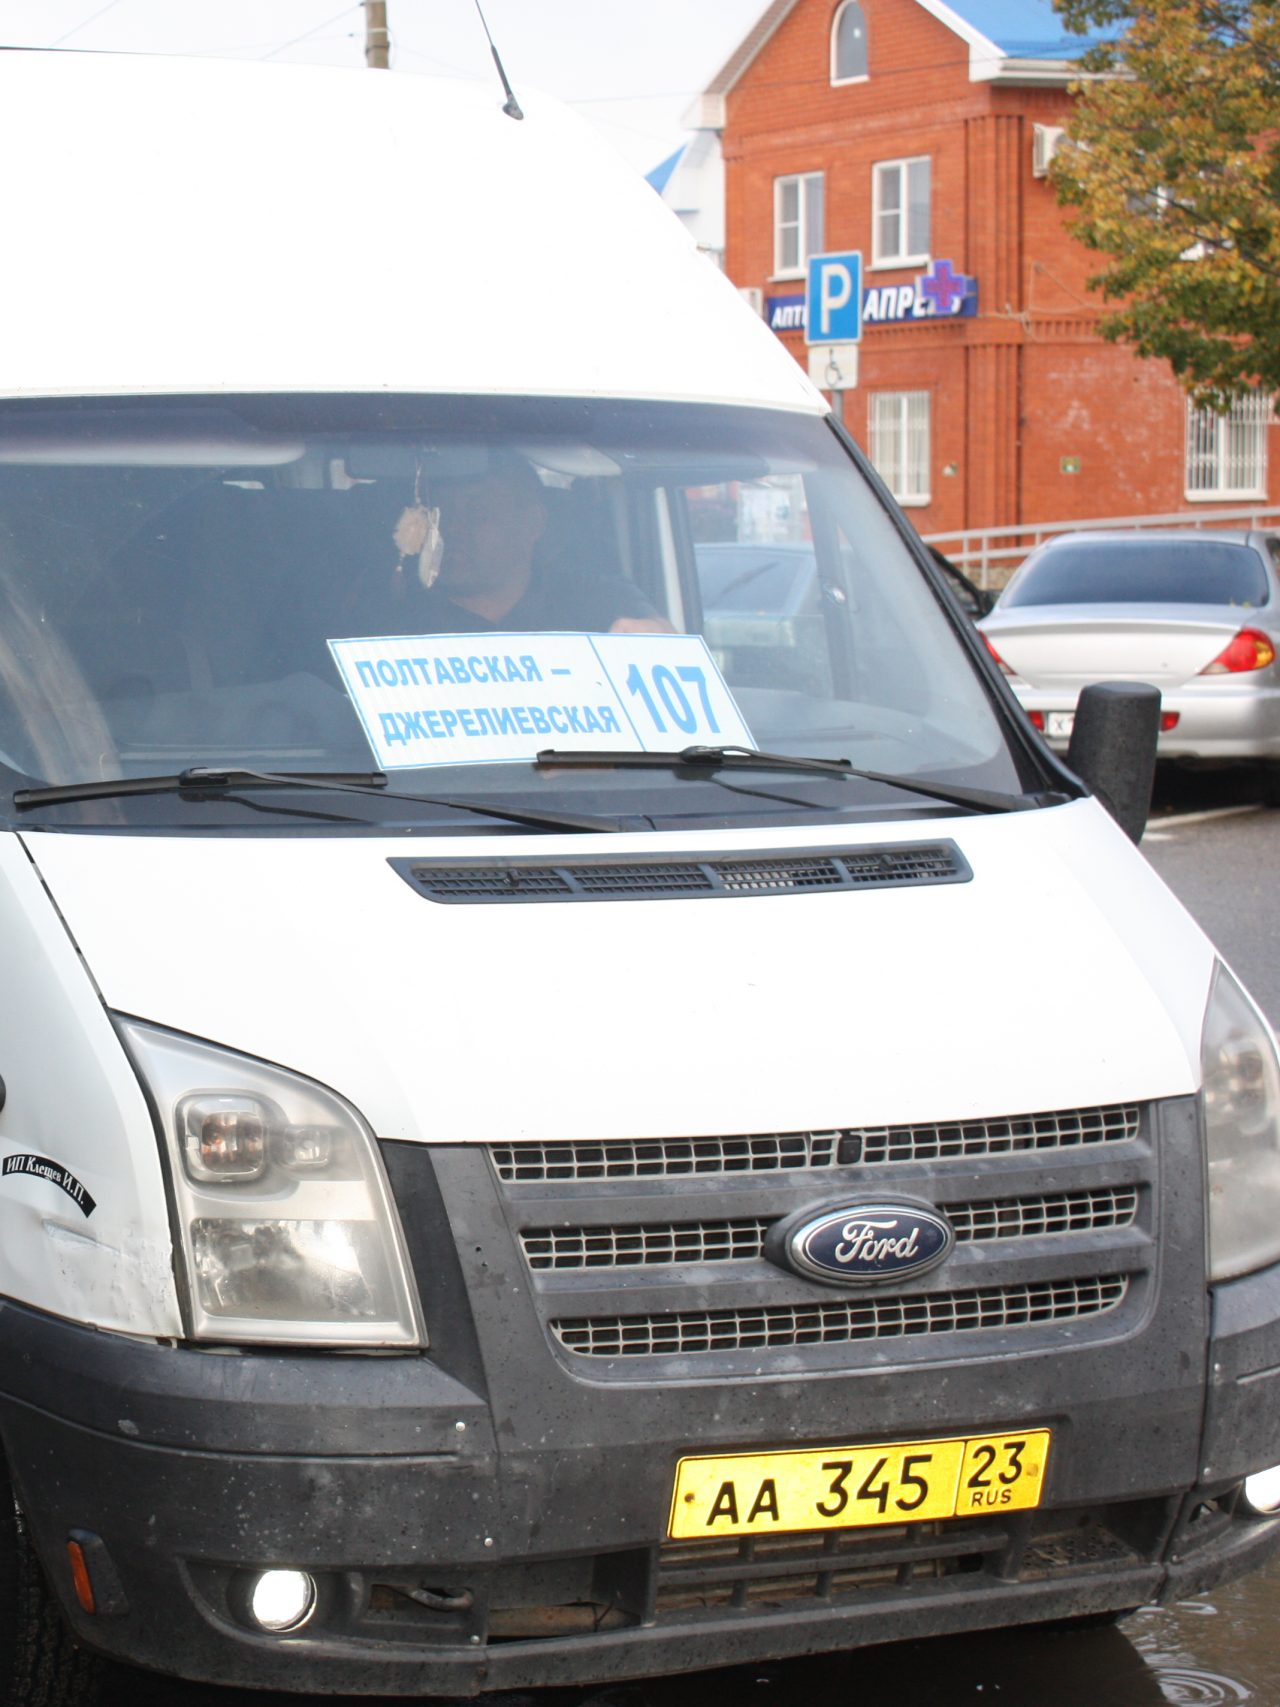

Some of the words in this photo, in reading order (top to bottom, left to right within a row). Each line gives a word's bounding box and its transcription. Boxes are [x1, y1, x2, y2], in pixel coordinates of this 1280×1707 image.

[821, 263, 852, 334] P
[354, 654, 543, 688] ПОЛТАВСКАЯ
[626, 663, 721, 735] 107
[378, 705, 622, 747] ДЖЕРЕЛИЕВСКАЯ
[6, 1156, 26, 1172] ИП
[835, 1219, 920, 1264] Ford
[706, 1478, 780, 1526] AA
[816, 1454, 933, 1517] 345
[967, 1441, 1027, 1488] 23
[971, 1488, 1012, 1507] RUS
